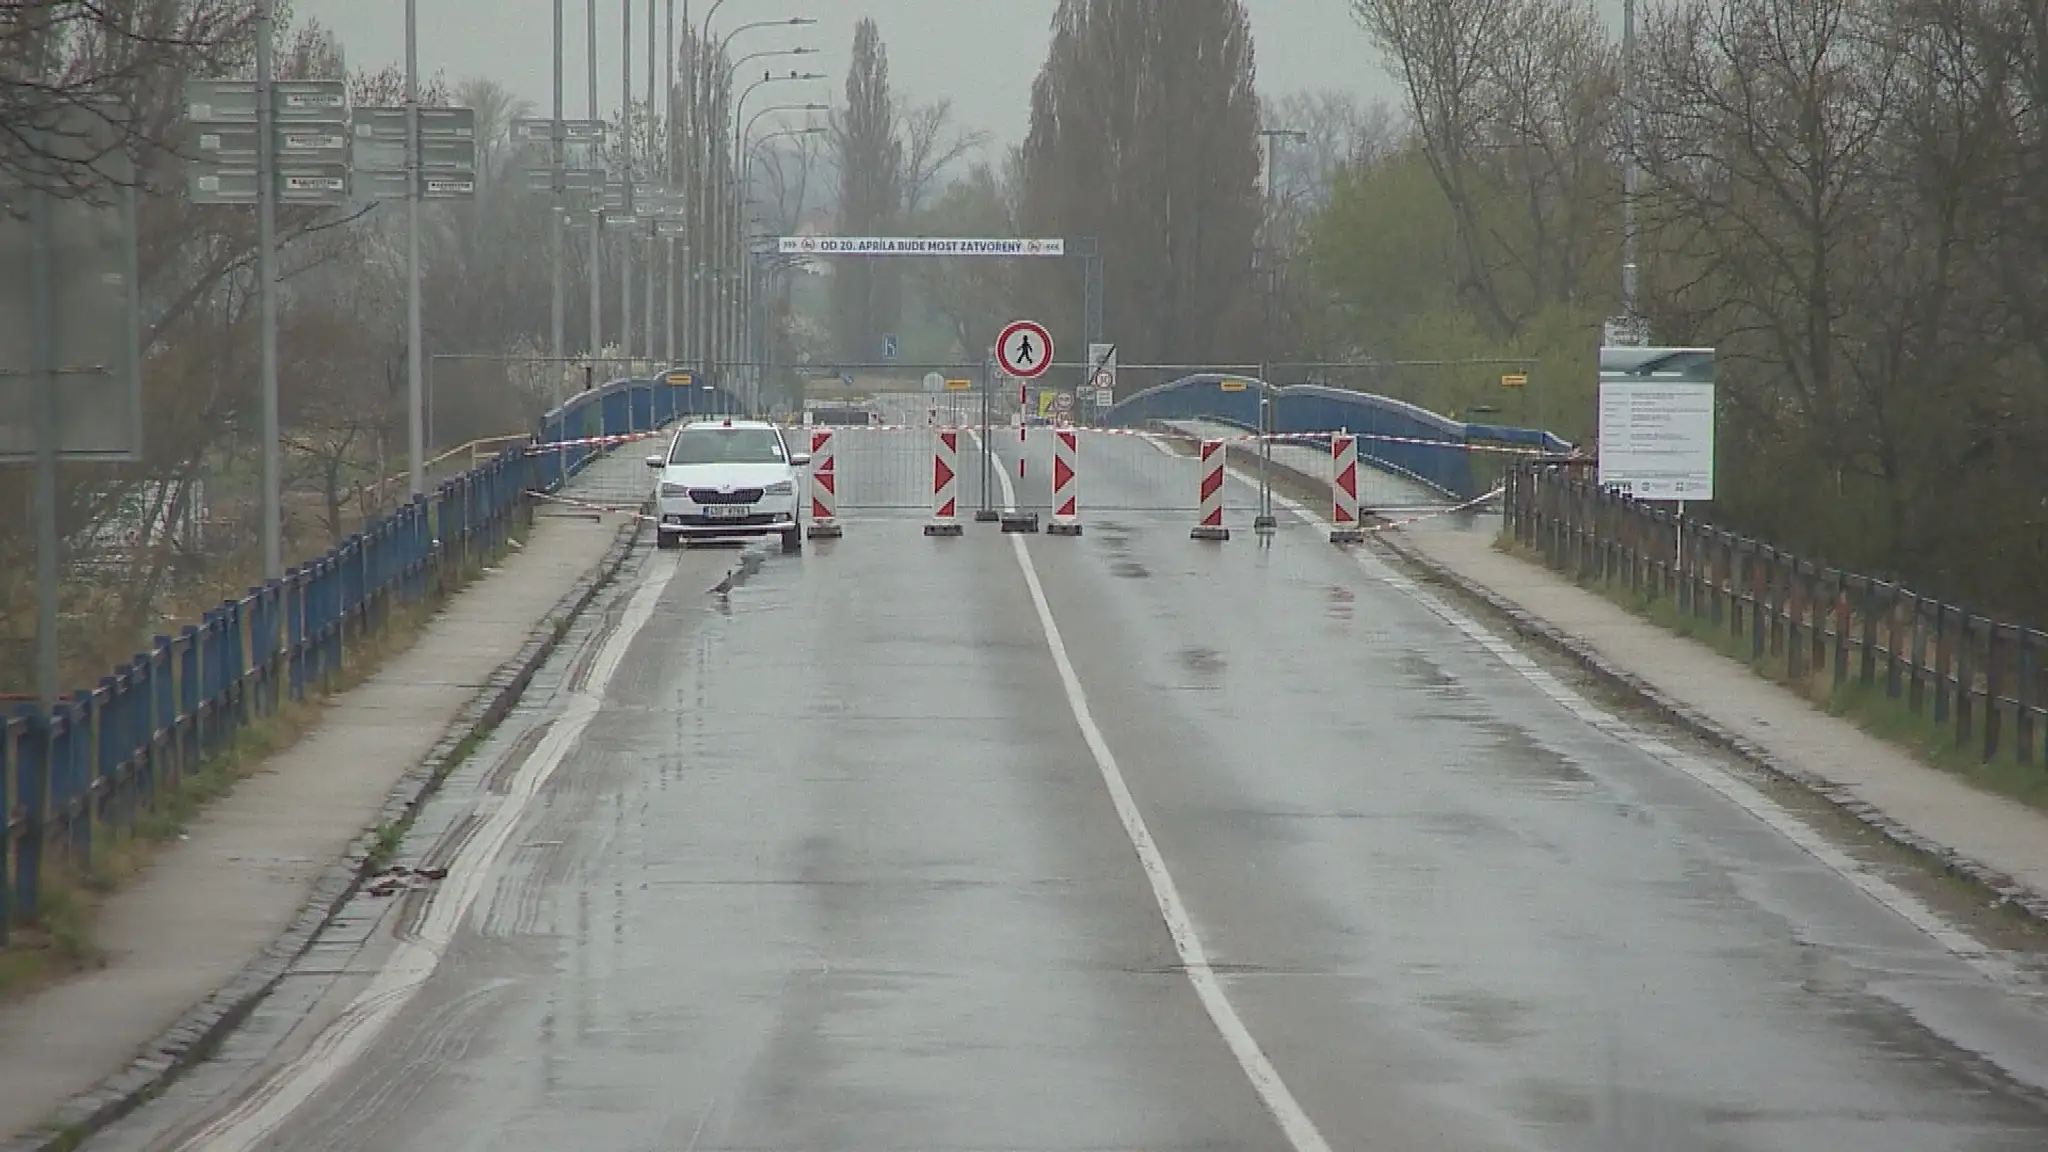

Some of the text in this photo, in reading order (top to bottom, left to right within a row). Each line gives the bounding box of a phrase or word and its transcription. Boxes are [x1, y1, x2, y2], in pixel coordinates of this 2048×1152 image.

[821, 241, 838, 251] OD
[859, 239, 895, 251] APRÍLA
[898, 241, 926, 251] BUDE
[928, 241, 957, 251] MOST
